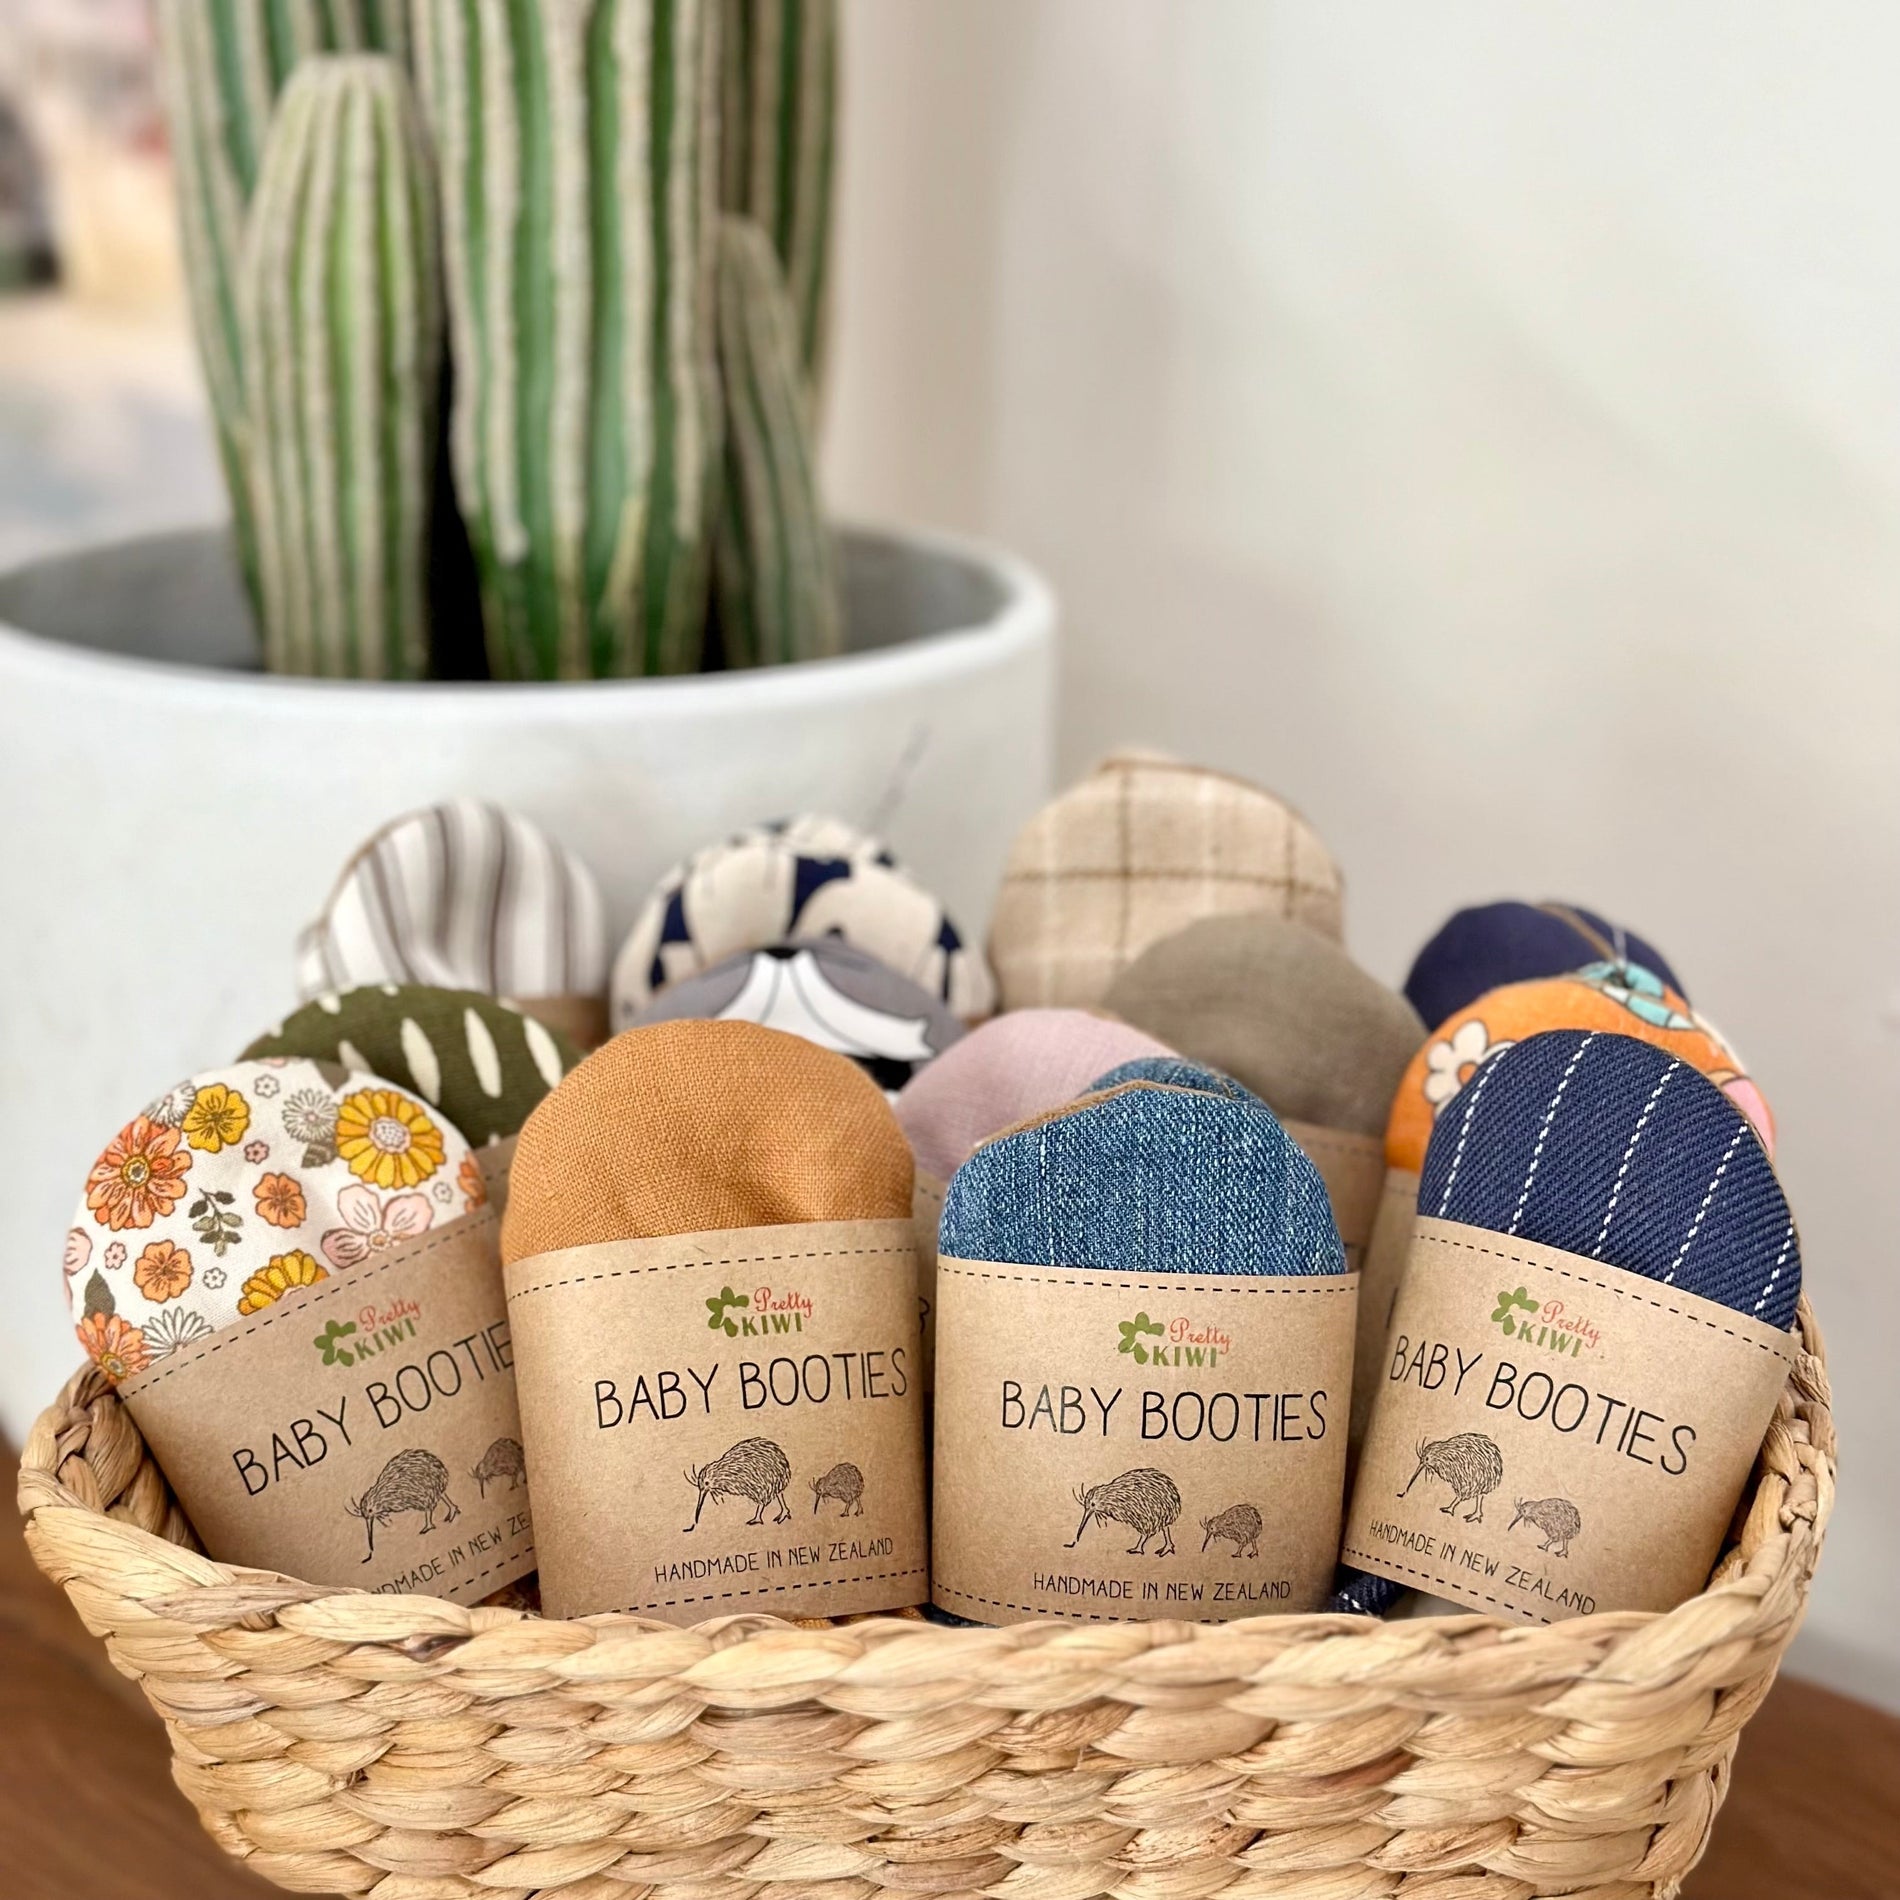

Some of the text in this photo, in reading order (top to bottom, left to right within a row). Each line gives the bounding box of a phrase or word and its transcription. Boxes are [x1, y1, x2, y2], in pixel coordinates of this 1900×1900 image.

[359, 1299, 421, 1332] Pretty
[753, 1287, 813, 1319] Pretty
[354, 1318, 417, 1361] KIWI
[741, 1313, 803, 1337] KIWI
[1169, 1316, 1233, 1354] Pretty
[1517, 1319, 1584, 1358] KIWI
[1541, 1300, 1601, 1348] Pretty
[1152, 1345, 1218, 1368] KIWI
[233, 1320, 514, 1496] BABY BOOTIE
[595, 1348, 908, 1429] BABY BOOTIES
[1389, 1335, 1697, 1476] BABY BOOTIES
[1001, 1381, 1328, 1442] BABY BOOTIES
[448, 1546, 466, 1567] IN
[468, 1527, 502, 1556] NEW
[654, 1537, 894, 1583] HANDMADE IN NEW ZEALAND
[1033, 1572, 1291, 1601] HANDMADE IN NEW ZEALAND
[1369, 1520, 1596, 1616] HANDMADE IN NEW ZEALAND
